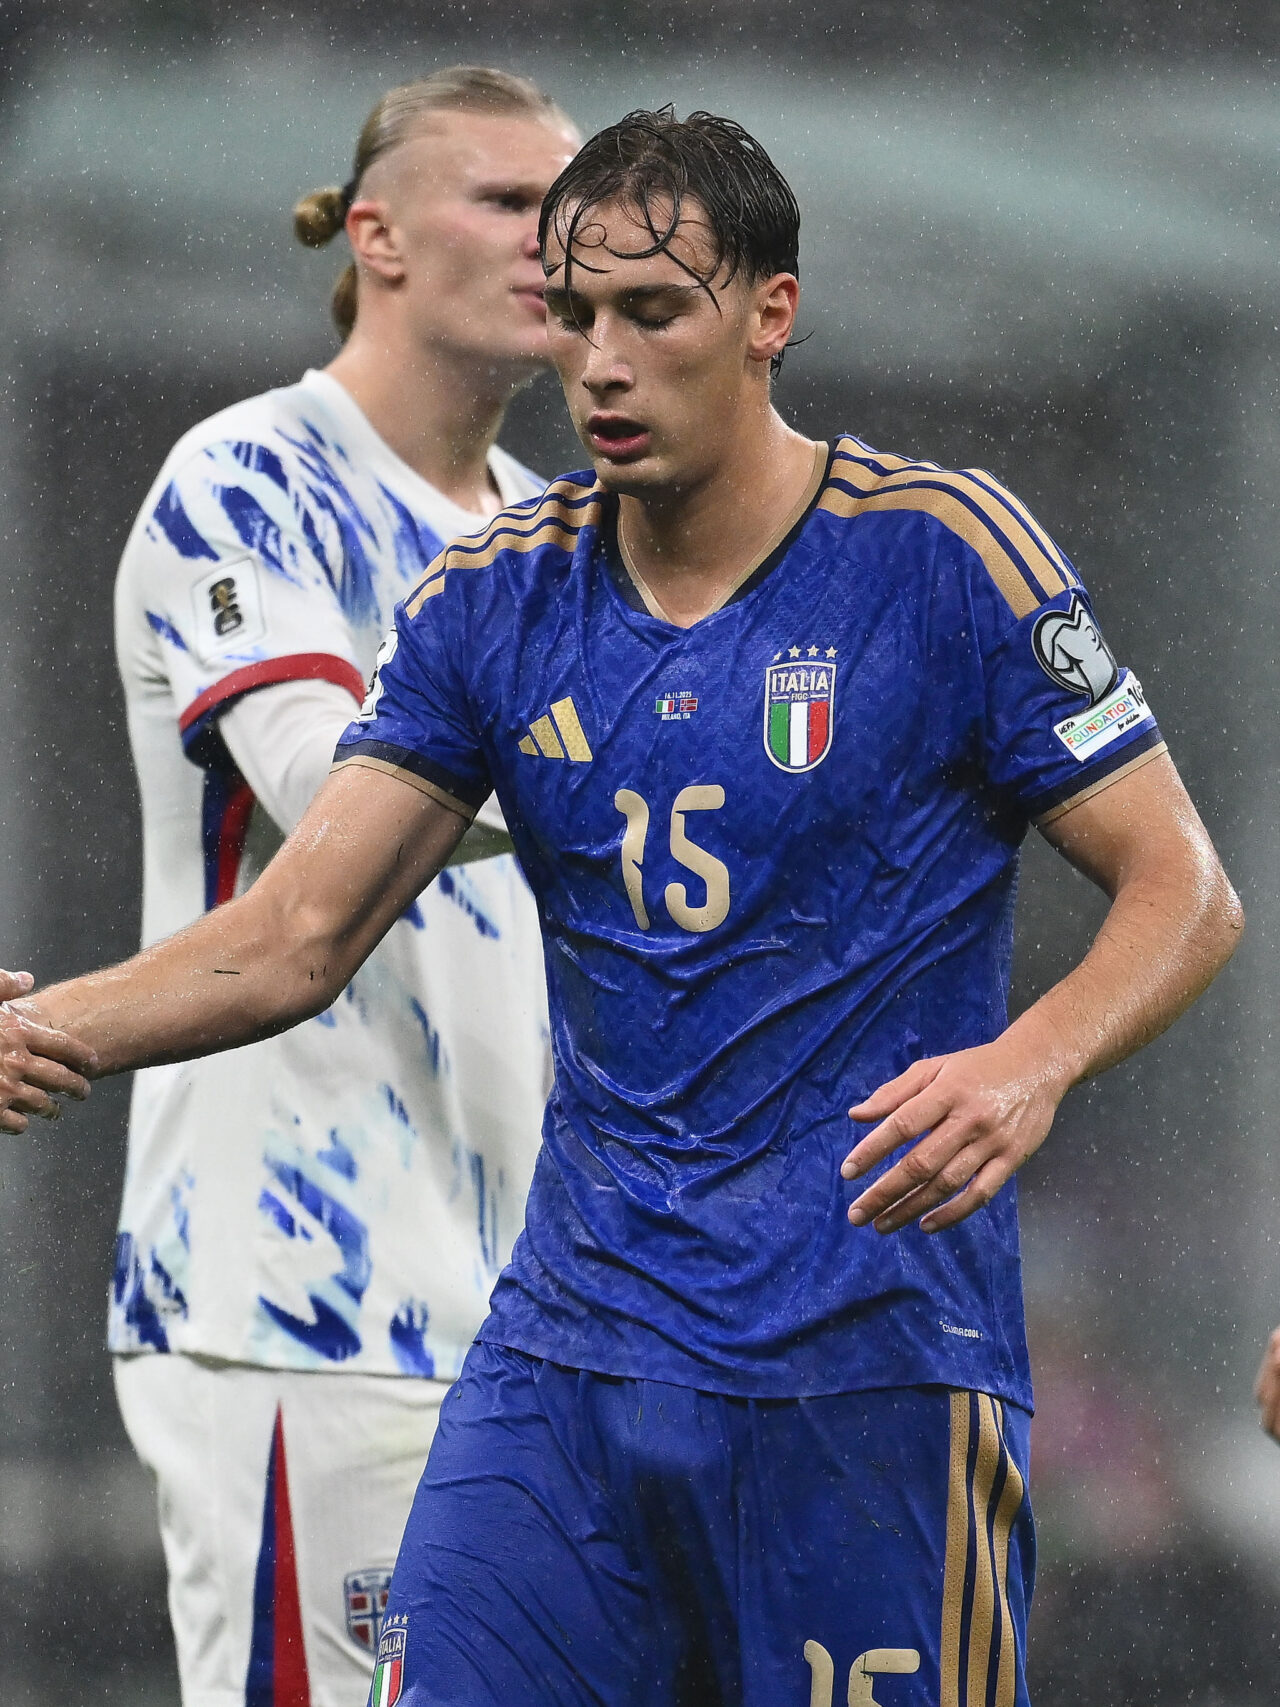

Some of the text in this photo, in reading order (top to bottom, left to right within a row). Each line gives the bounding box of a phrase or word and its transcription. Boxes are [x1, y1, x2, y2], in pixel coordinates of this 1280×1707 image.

[771, 671, 829, 693] ITALIA
[1059, 721, 1076, 735] UEFA
[1066, 697, 1133, 748] FOUNDATION
[614, 784, 731, 933] 15
